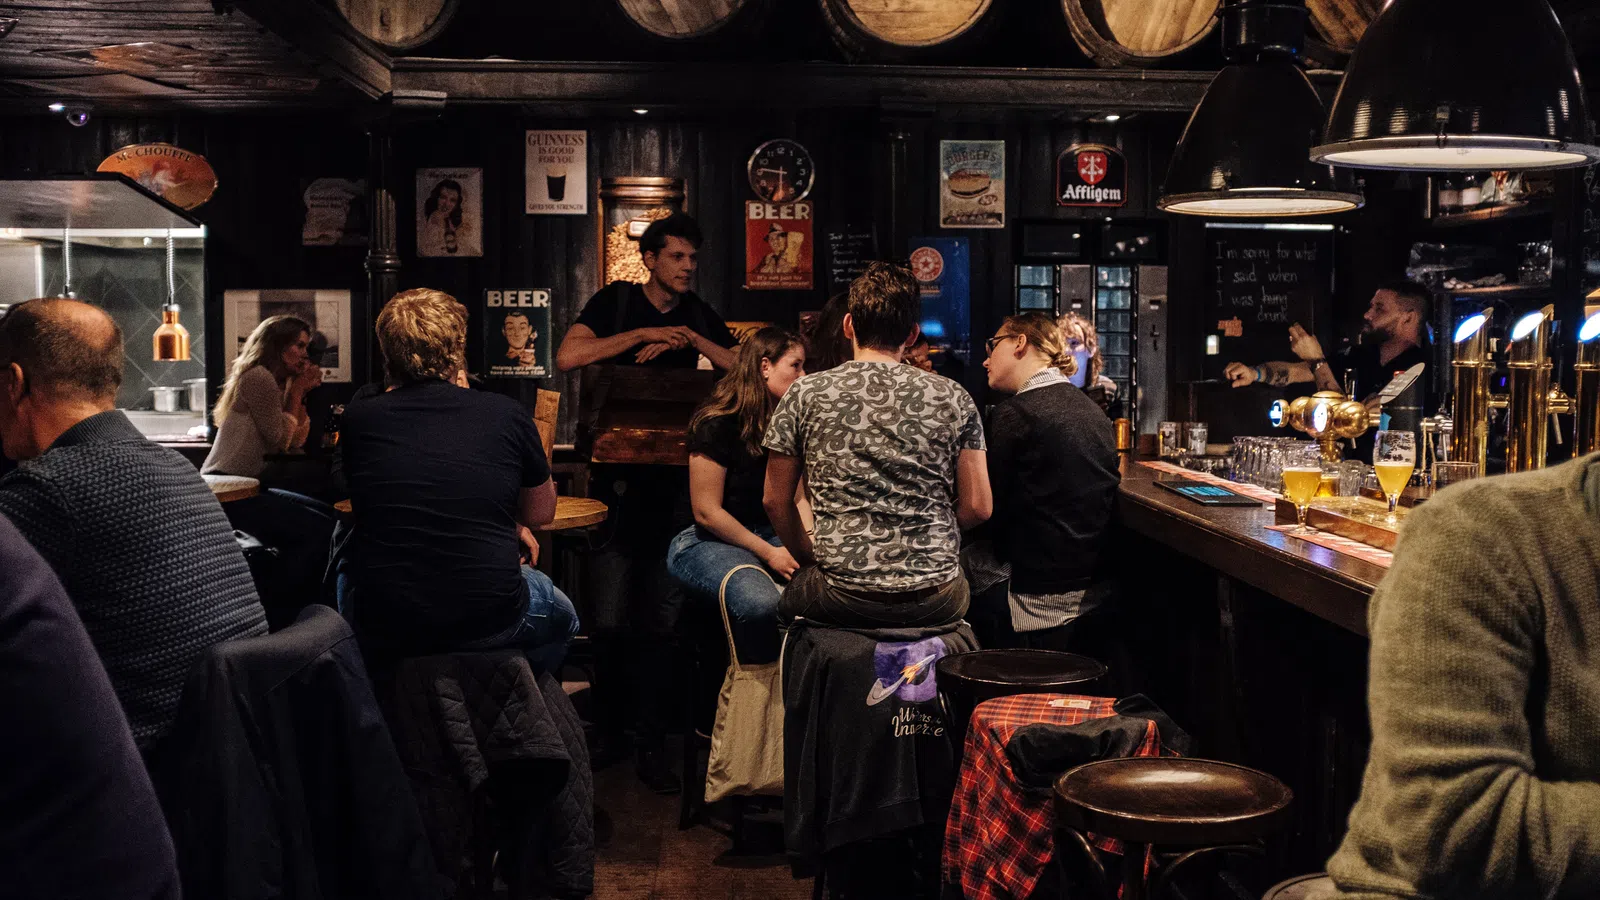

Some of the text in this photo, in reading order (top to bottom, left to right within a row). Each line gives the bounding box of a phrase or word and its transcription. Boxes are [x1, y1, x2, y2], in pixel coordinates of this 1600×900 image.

[527, 133, 584, 146] GUINNESS
[538, 156, 574, 164] FOR YOU
[796, 157, 802, 165] 2
[800, 168, 806, 176] 3
[1062, 183, 1121, 203] Affligem
[749, 202, 810, 220] BEER
[1242, 247, 1271, 264] sorry
[1276, 241, 1291, 259] for
[1216, 262, 1299, 283] I said when
[487, 290, 549, 308] BEER
[1216, 289, 1222, 307] I
[1231, 295, 1255, 307] was
[1257, 305, 1289, 323] drunk
